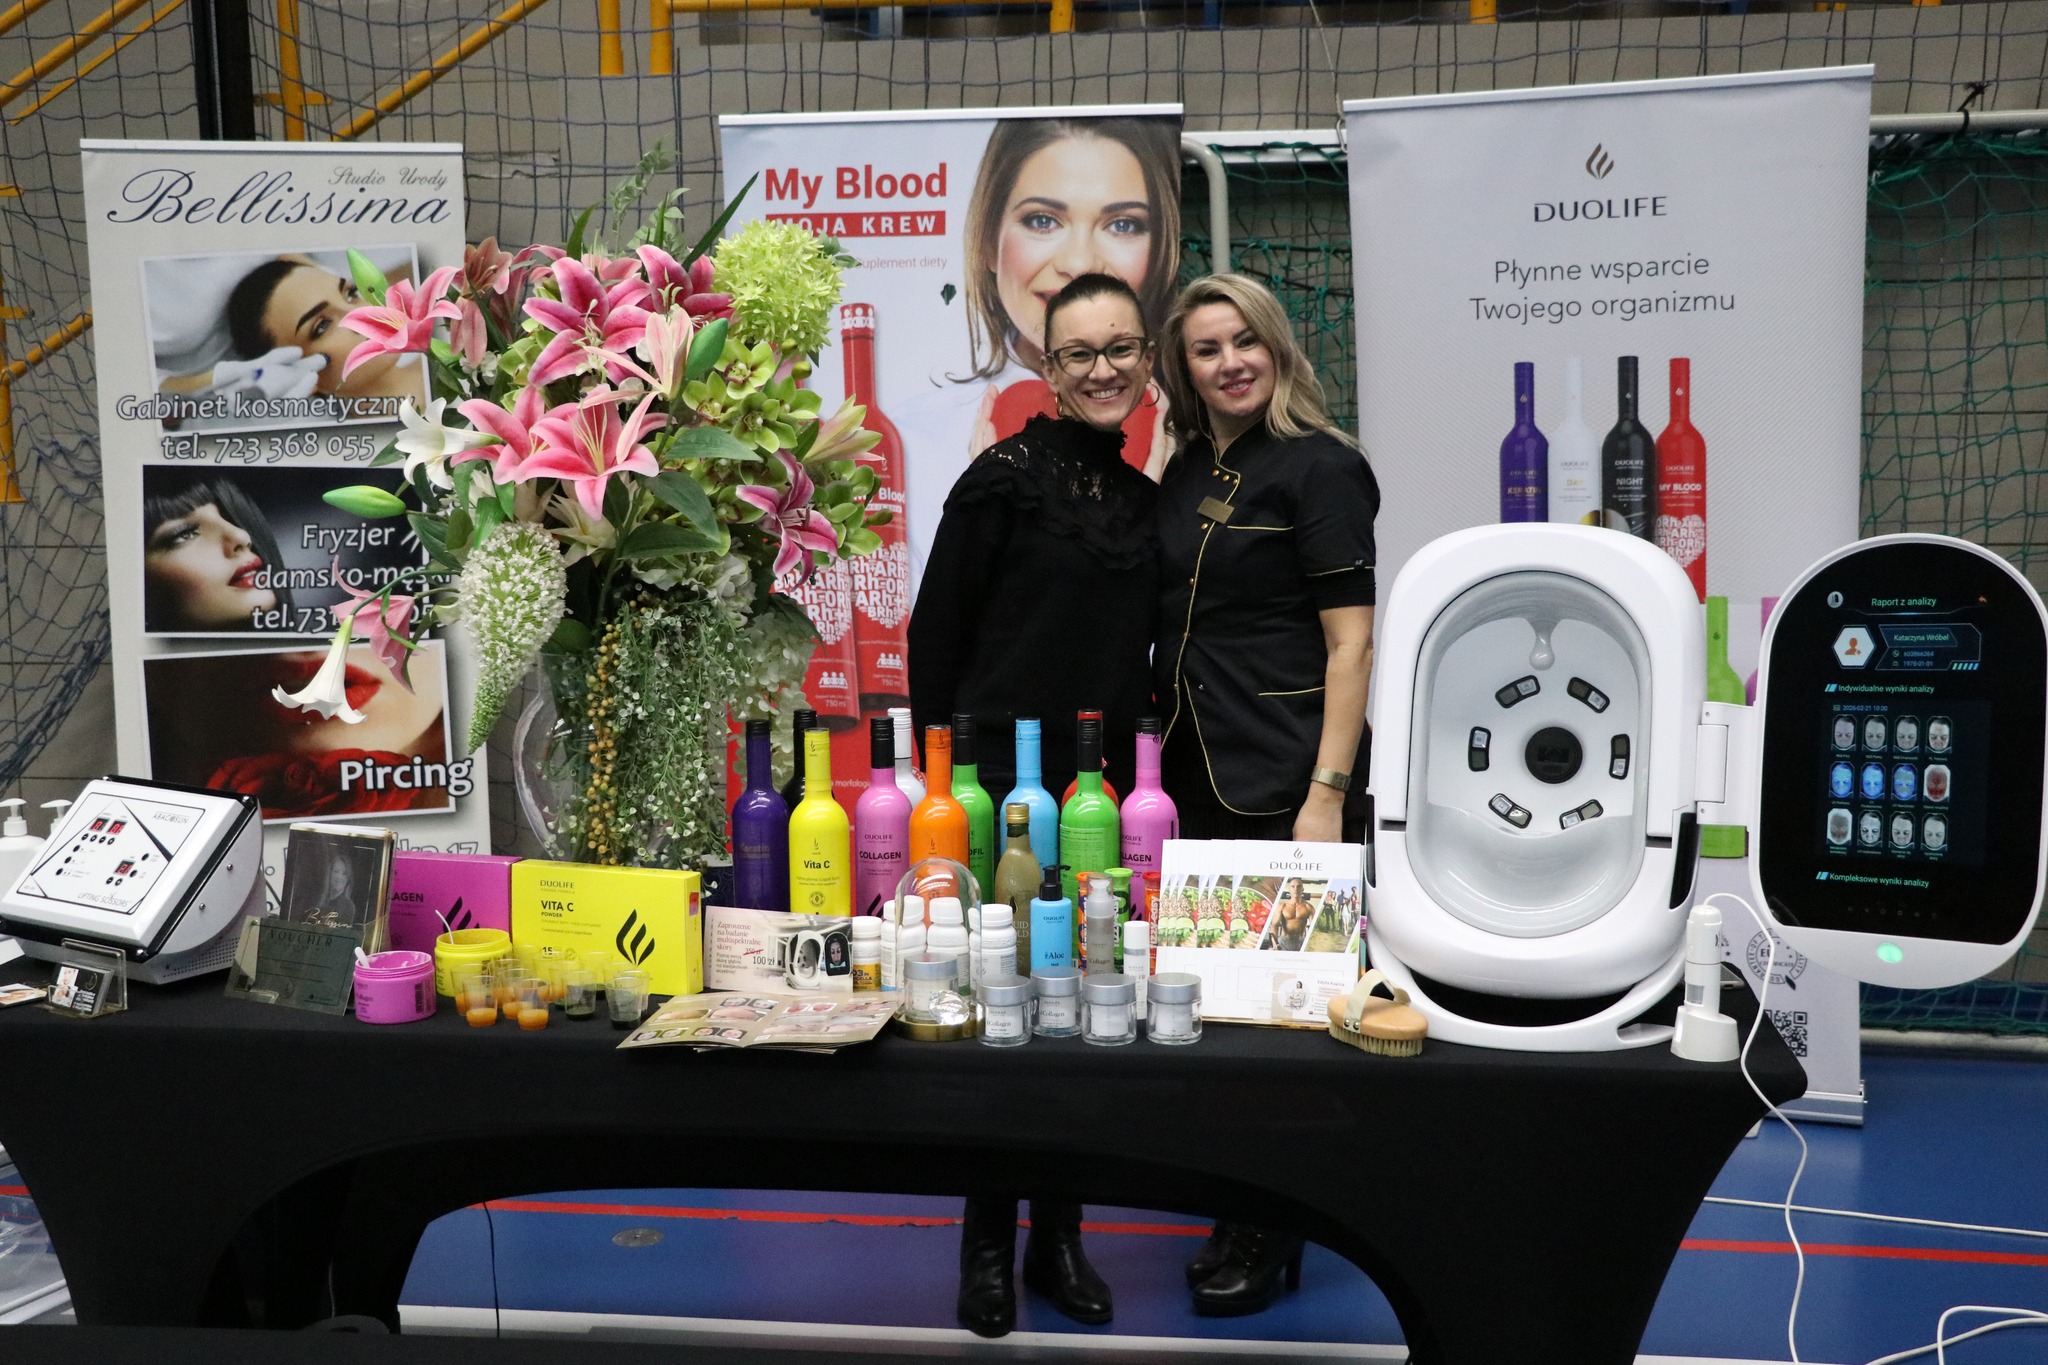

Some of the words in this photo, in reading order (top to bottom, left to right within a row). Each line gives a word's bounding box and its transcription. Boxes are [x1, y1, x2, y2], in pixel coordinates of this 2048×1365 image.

[328, 166, 386, 186] Studio
[399, 166, 448, 191] Urody
[765, 167, 823, 208] My
[836, 162, 948, 200] Blood
[107, 168, 451, 225] Bellissima
[1534, 195, 1668, 222] DUOLIFE
[862, 215, 936, 234] KREW
[920, 256, 948, 269] diety
[1494, 259, 1582, 289] Płynne
[1591, 252, 1710, 284] wsparcie
[1469, 296, 1582, 325] Twojego
[1591, 290, 1735, 321] organizmu
[116, 394, 227, 420] Gabinet
[162, 433, 206, 459] tel.
[215, 437, 262, 462] 723
[266, 432, 319, 462] 368
[329, 434, 375, 461] 055
[1672, 483, 1702, 491] BLOOD
[302, 523, 396, 554] Fryzjer
[1871, 597, 1898, 607] Raport
[1907, 596, 1936, 608] analizy
[1893, 634, 1925, 642] Katarzyna
[1925, 633, 1949, 641] Wróbel
[1838, 684, 1884, 693] Indywidualne
[1885, 684, 1908, 693] wyniki
[1908, 685, 1935, 694] analizy
[338, 754, 475, 798] Pircing
[835, 779, 871, 788] morfolog
[859, 851, 902, 860] COLLAGEN
[803, 860, 822, 869] Vita
[823, 860, 830, 869] C
[1269, 861, 1323, 871] DUOLIFE
[540, 879, 575, 889] DUOLIFE
[1829, 873, 1878, 884] Kompleksowe
[1880, 877, 1902, 886] wyniki
[1903, 878, 1929, 888] analizy
[391, 891, 424, 903] AGEN
[541, 899, 564, 911] VITA
[566, 902, 574, 912] C
[717, 921, 751, 930] Zaproszenie
[716, 937, 761, 945] multispektralne
[542, 946, 553, 956] 15
[752, 956, 767, 965] 100
[768, 957, 775, 965] zł
